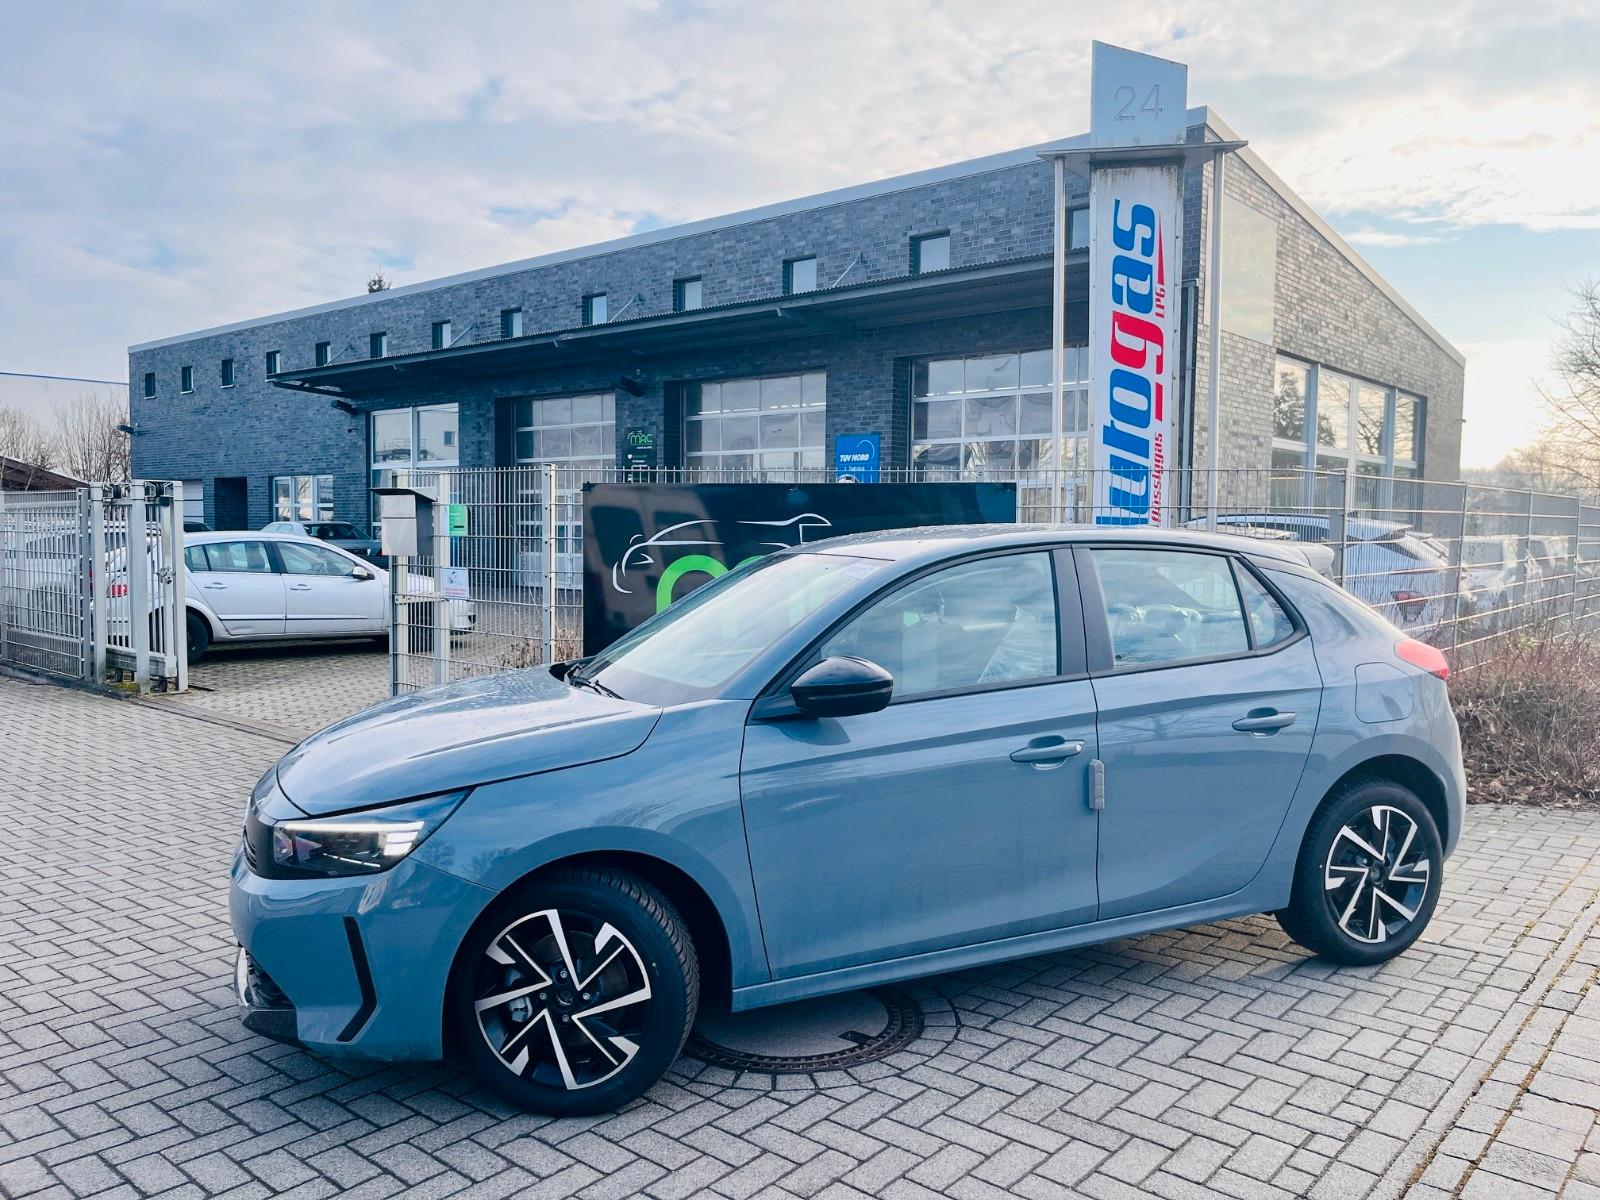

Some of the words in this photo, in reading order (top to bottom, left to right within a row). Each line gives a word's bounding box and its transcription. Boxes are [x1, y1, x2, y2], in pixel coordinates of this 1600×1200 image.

[1114, 84, 1163, 121] 24
[1154, 287, 1166, 319] LPG
[852, 453, 869, 461] NORD
